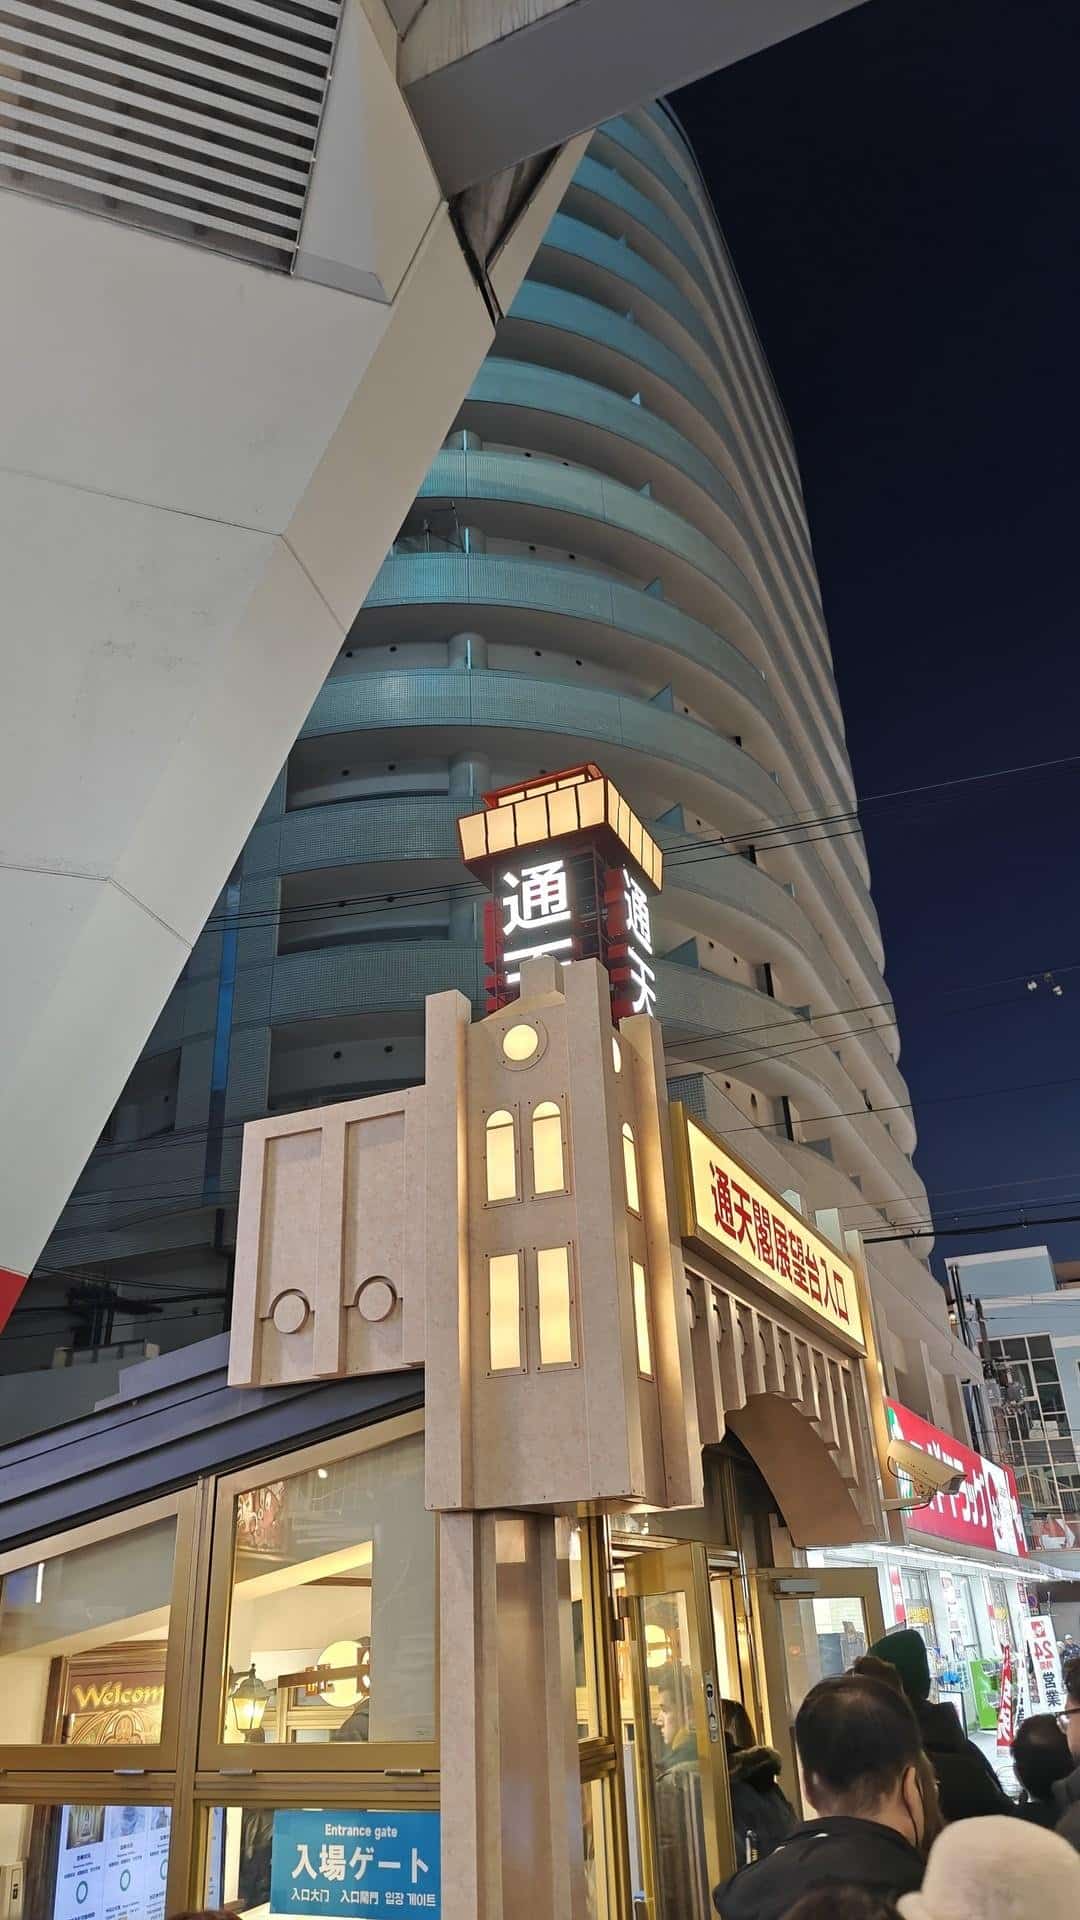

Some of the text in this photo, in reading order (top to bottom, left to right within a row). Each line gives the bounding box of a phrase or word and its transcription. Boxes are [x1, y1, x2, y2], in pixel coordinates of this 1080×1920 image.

[623, 866, 657, 1016] 通天
[709, 1160, 850, 1325] 通天閣展望台入口
[325, 1823, 398, 1840] Entrance gate
[291, 1843, 429, 1884] 入場ゲート
[406, 1892, 436, 1907] 게이트
